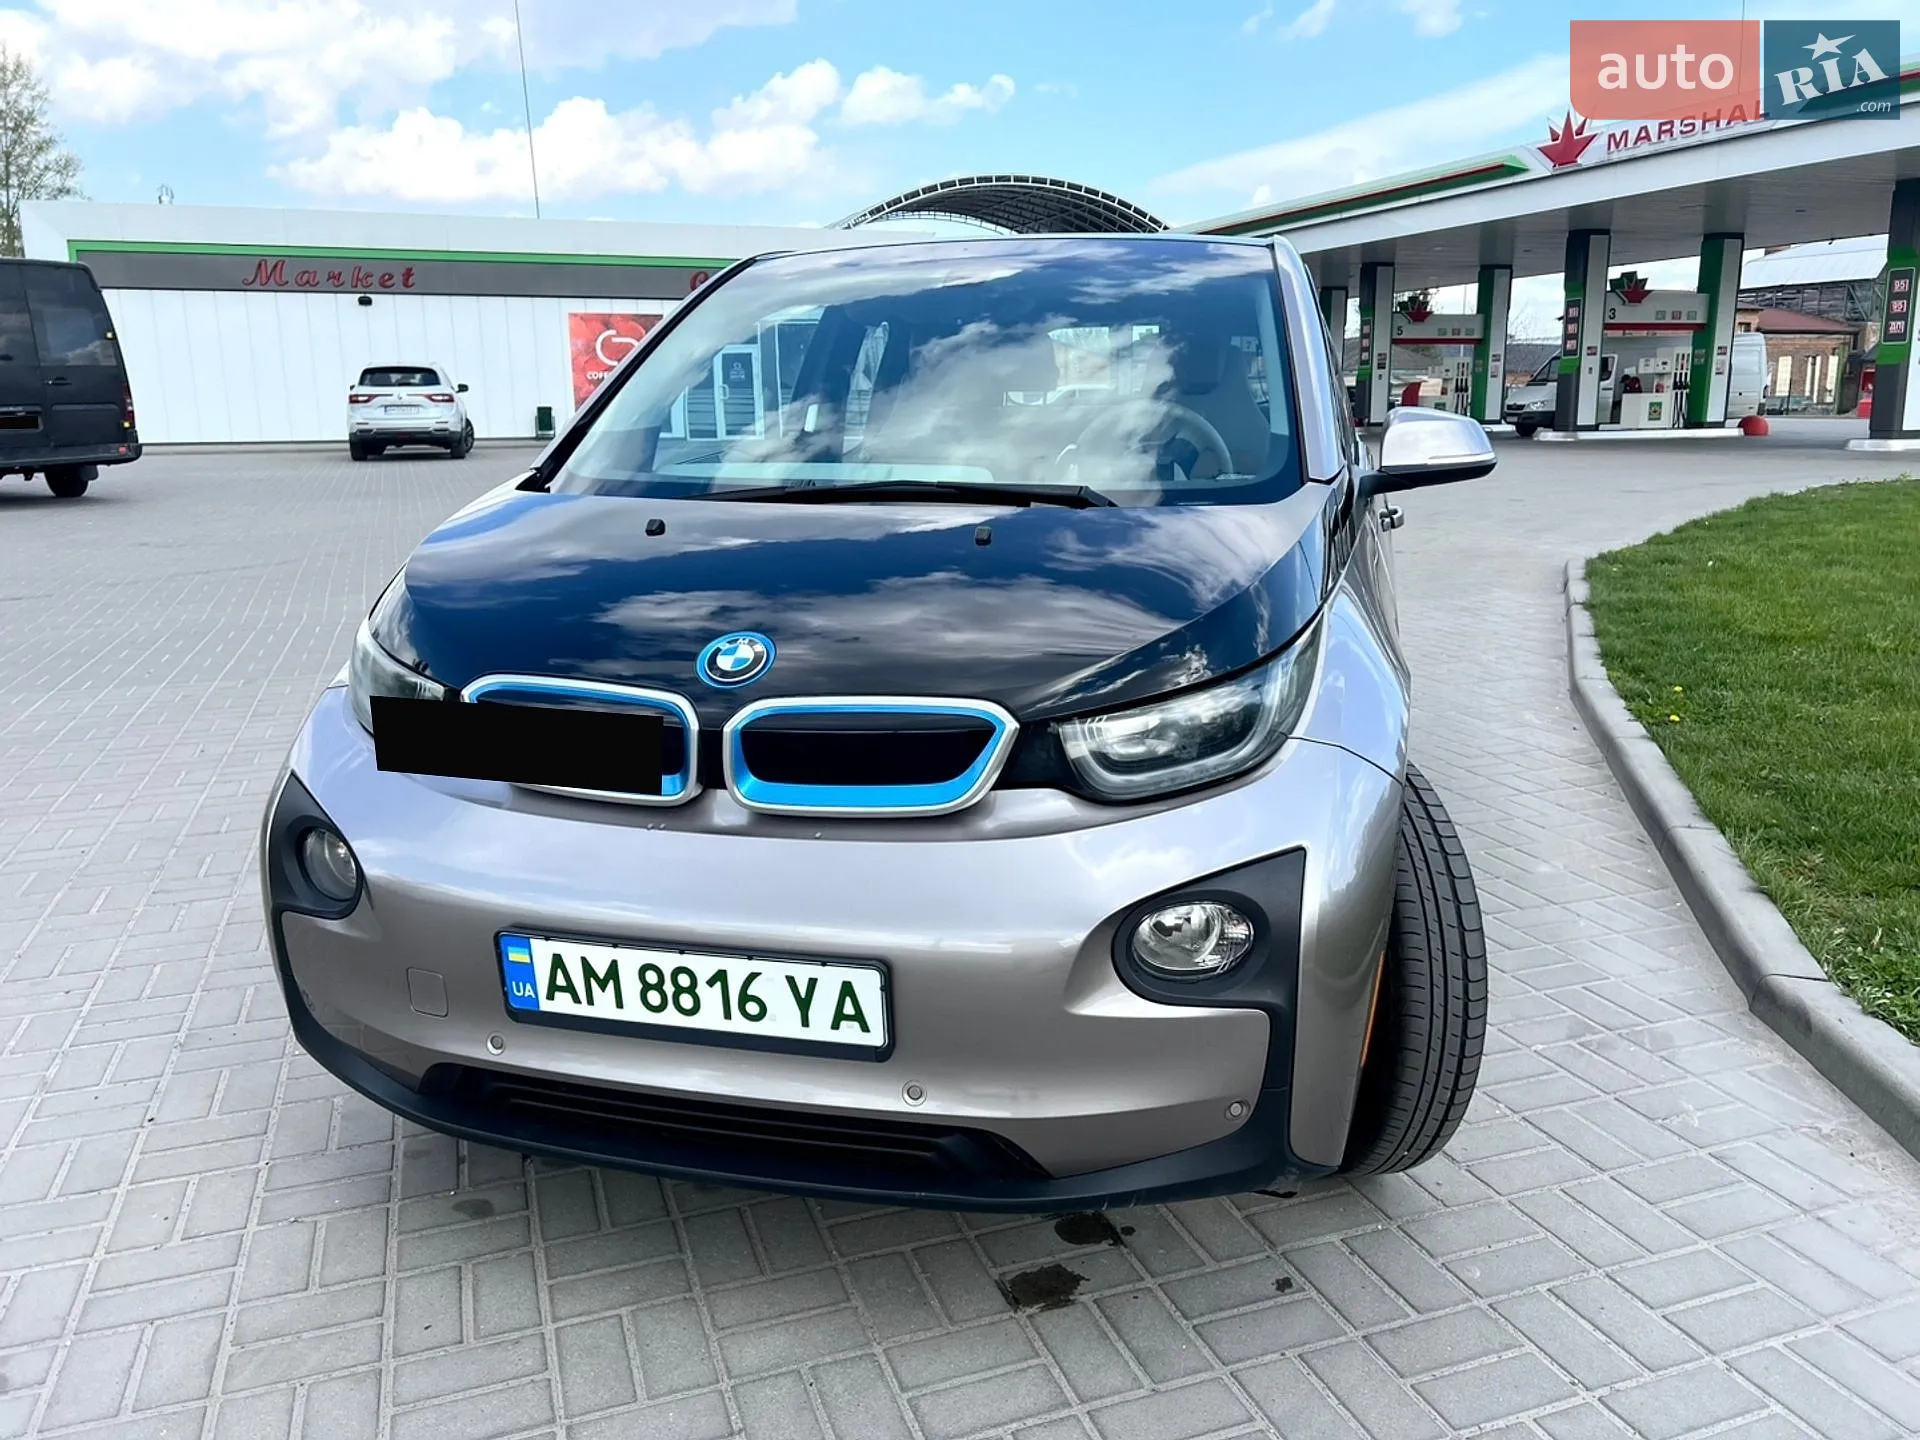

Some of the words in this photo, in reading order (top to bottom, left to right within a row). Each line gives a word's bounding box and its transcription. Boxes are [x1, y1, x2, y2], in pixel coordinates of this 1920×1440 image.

[242, 258, 417, 290] Market
[1608, 308, 1616, 320] 3
[512, 980, 535, 999] UA
[545, 952, 624, 1009] AM
[637, 962, 768, 1022] 8816
